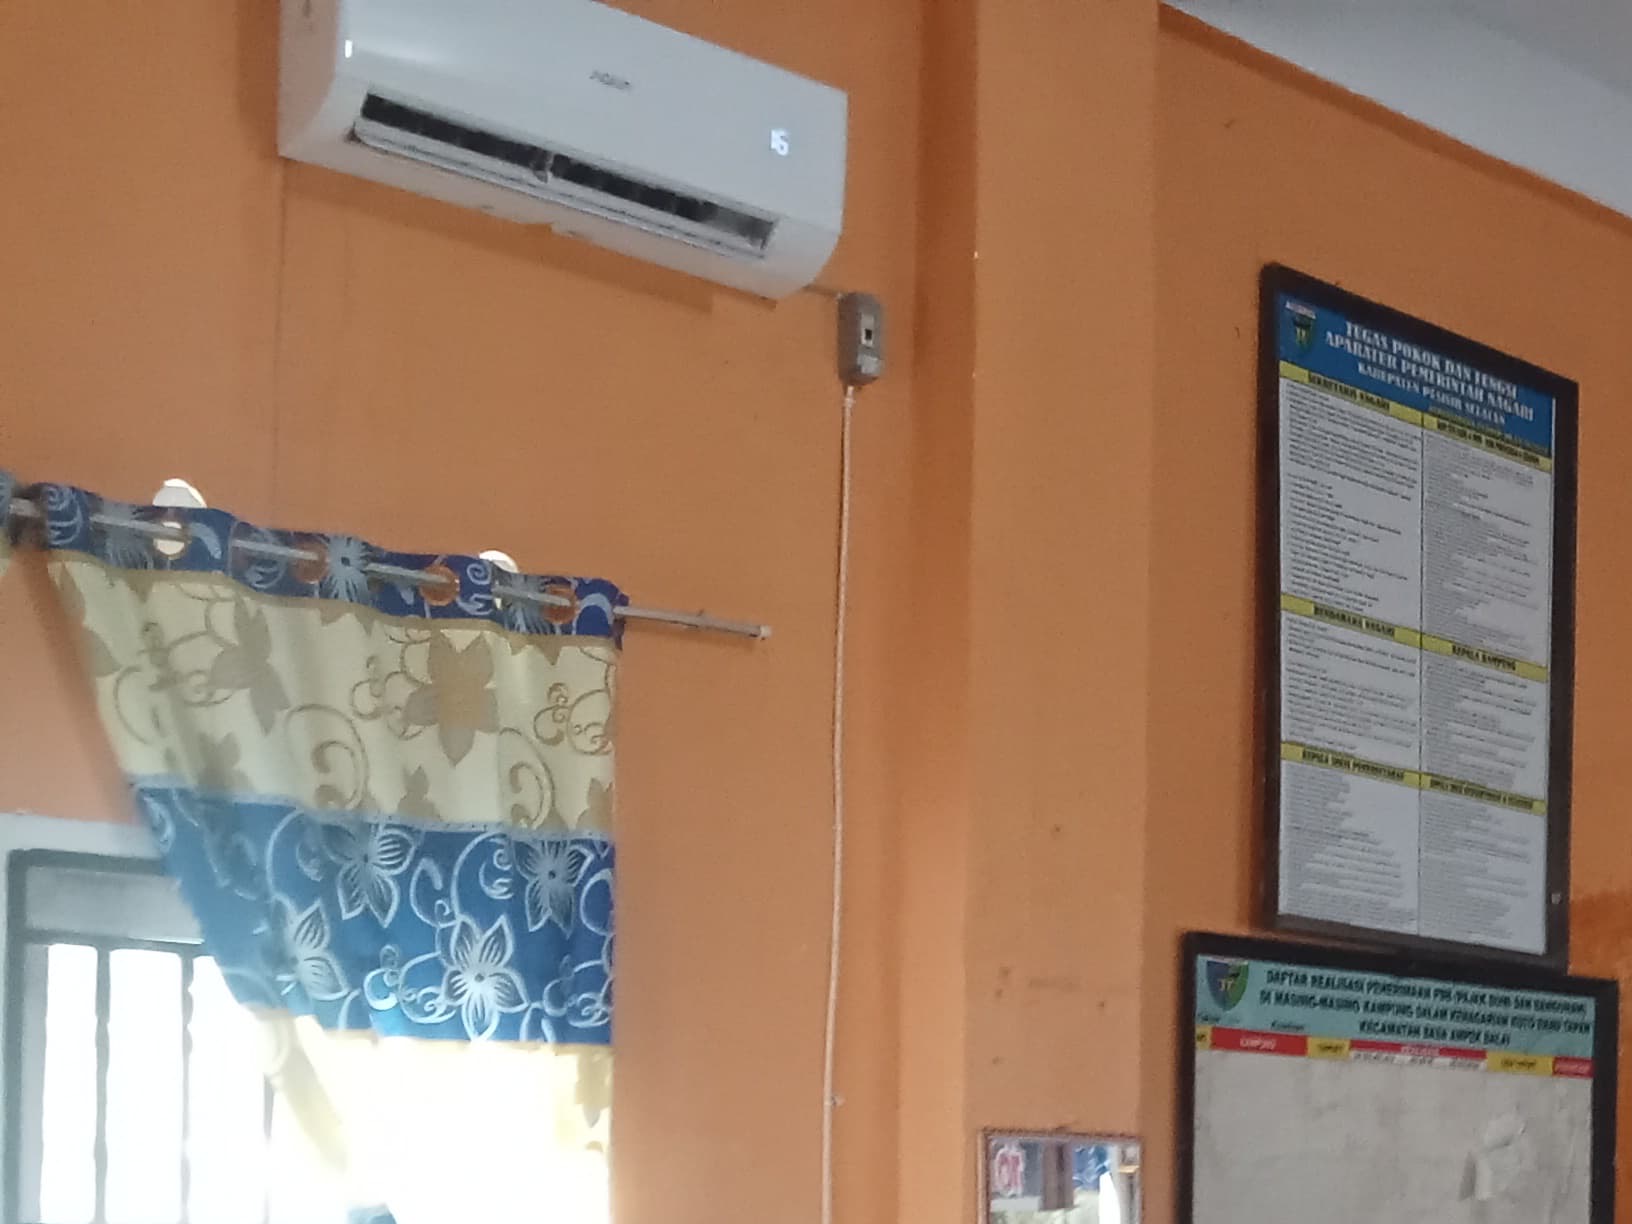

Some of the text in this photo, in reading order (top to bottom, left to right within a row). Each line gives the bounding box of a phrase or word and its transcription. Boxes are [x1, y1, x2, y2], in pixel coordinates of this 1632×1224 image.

[1392, 338, 1441, 372] POKOK
[1444, 357, 1472, 382] DAN
[1400, 358, 1485, 400] PEMERINTAH
[1487, 388, 1534, 422] NAGARI
[1266, 970, 1308, 986] DAFTAR
[1311, 973, 1365, 991] REALISASI
[1274, 990, 1361, 1012] MASING-MASING
[1362, 1000, 1413, 1017] KAMPUNG
[1415, 1005, 1448, 1020] DALAM
[1359, 1020, 1420, 1037] KECAMATAN
